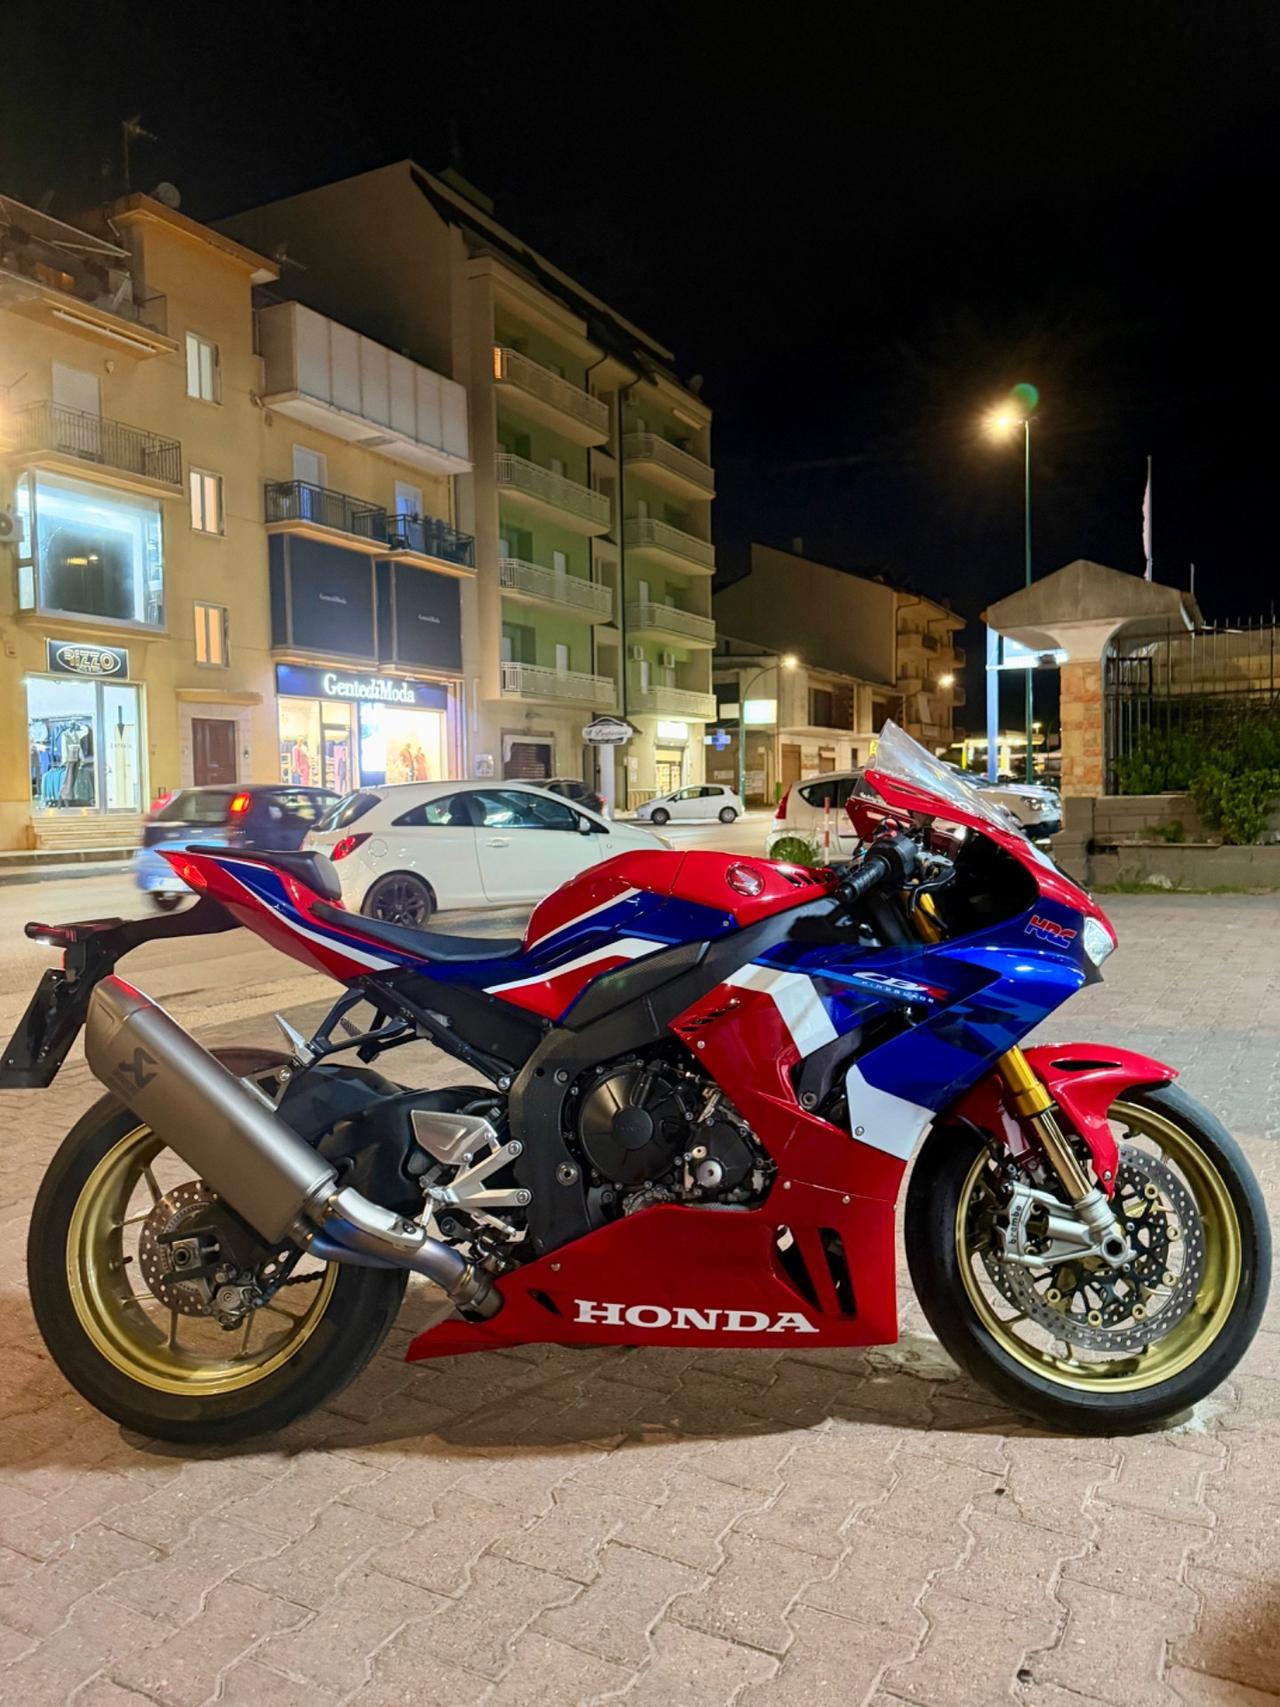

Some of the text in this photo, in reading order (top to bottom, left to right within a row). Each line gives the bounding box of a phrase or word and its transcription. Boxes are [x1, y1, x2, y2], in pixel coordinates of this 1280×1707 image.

[323, 673, 416, 703] GentediModa
[1024, 914, 1078, 949] HRC
[1008, 1205, 1022, 1245] brembo
[573, 1299, 820, 1333] HONDA
